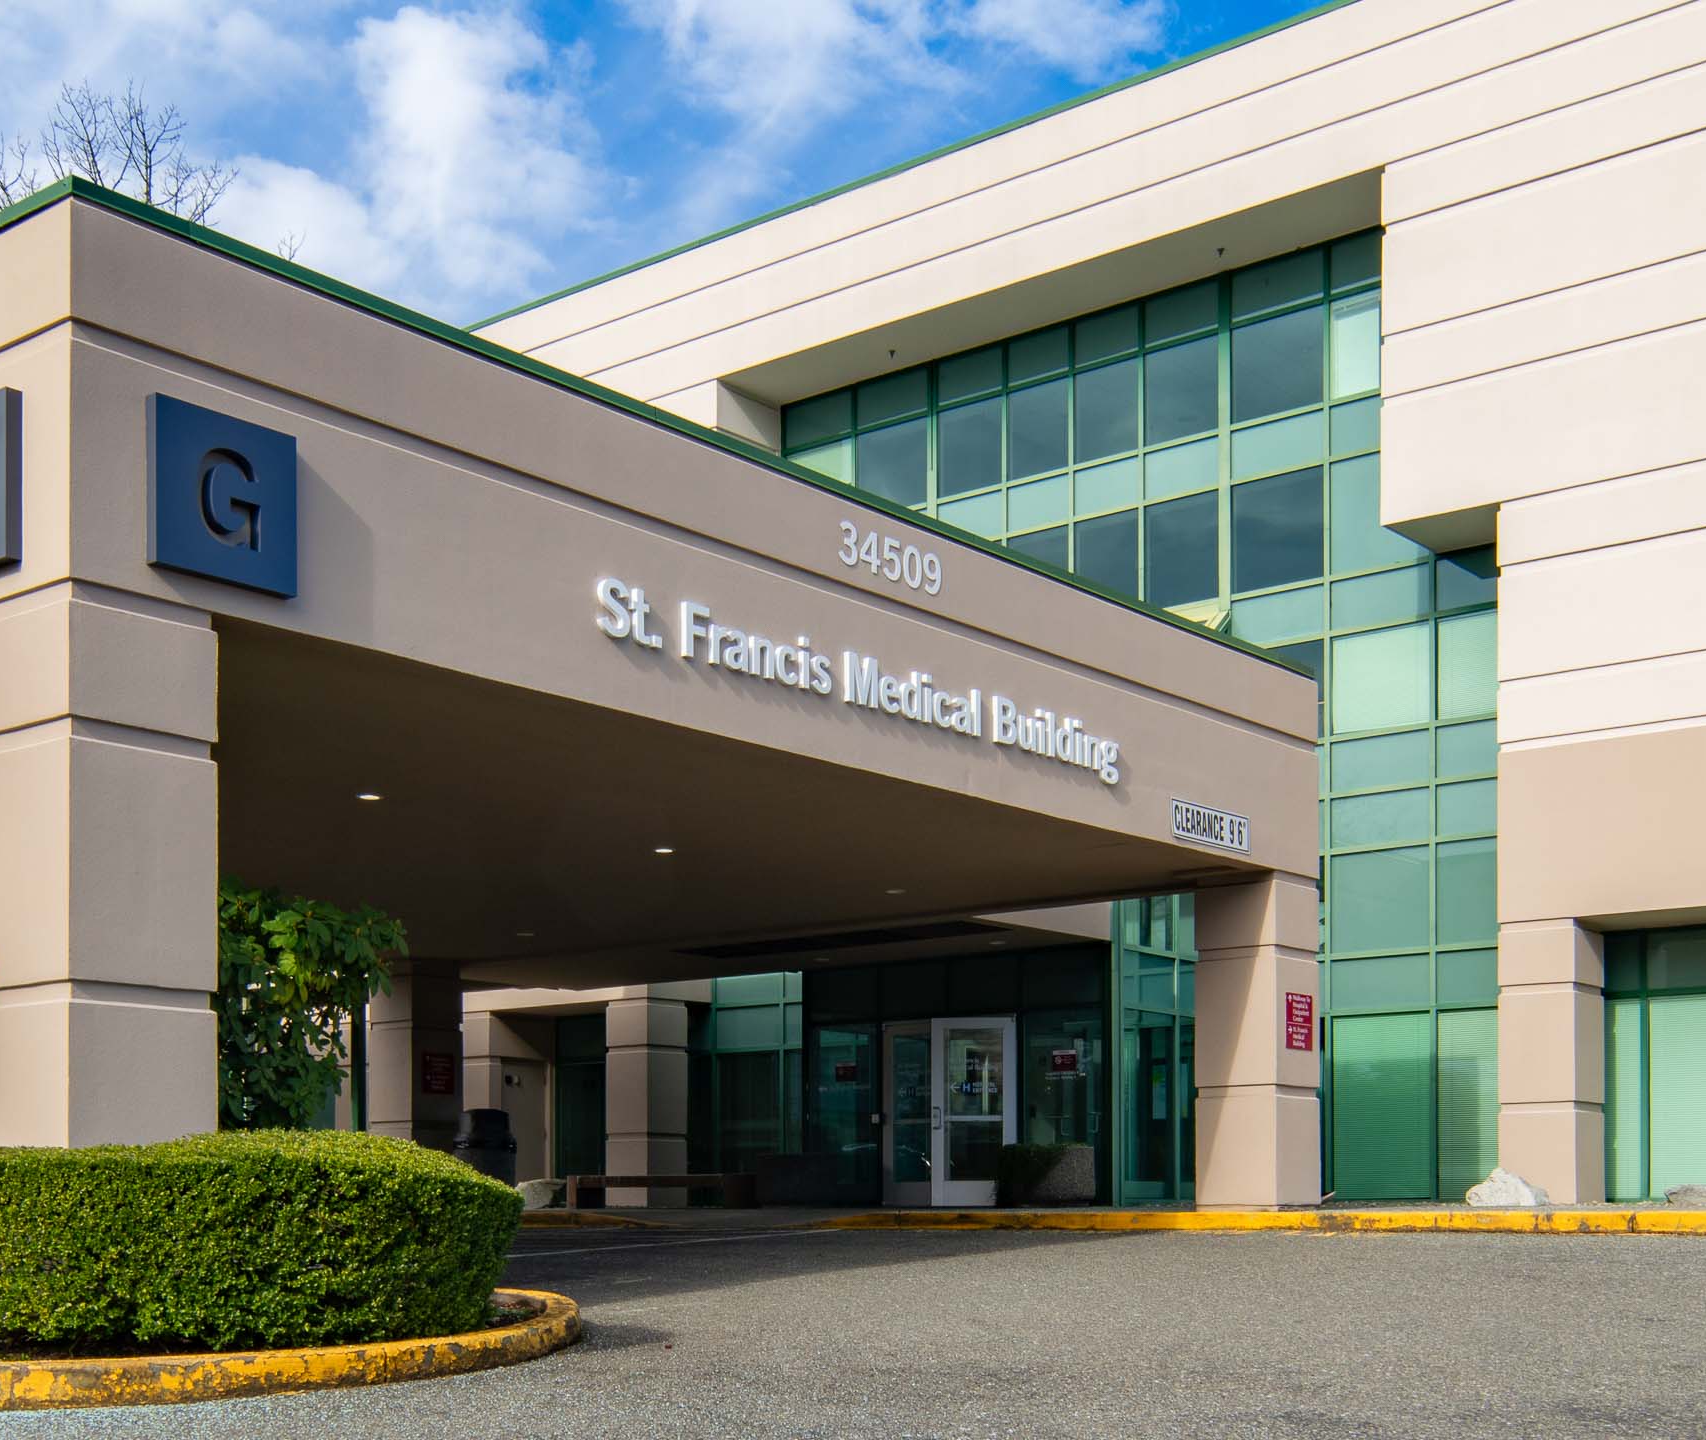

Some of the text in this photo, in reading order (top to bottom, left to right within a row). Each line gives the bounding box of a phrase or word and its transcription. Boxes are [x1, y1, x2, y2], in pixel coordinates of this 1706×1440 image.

[198, 447, 261, 552] G
[838, 519, 942, 596] 34509
[596, 578, 1120, 786] St. Francis Medical Building
[1174, 803, 1225, 842] CLEARANCE
